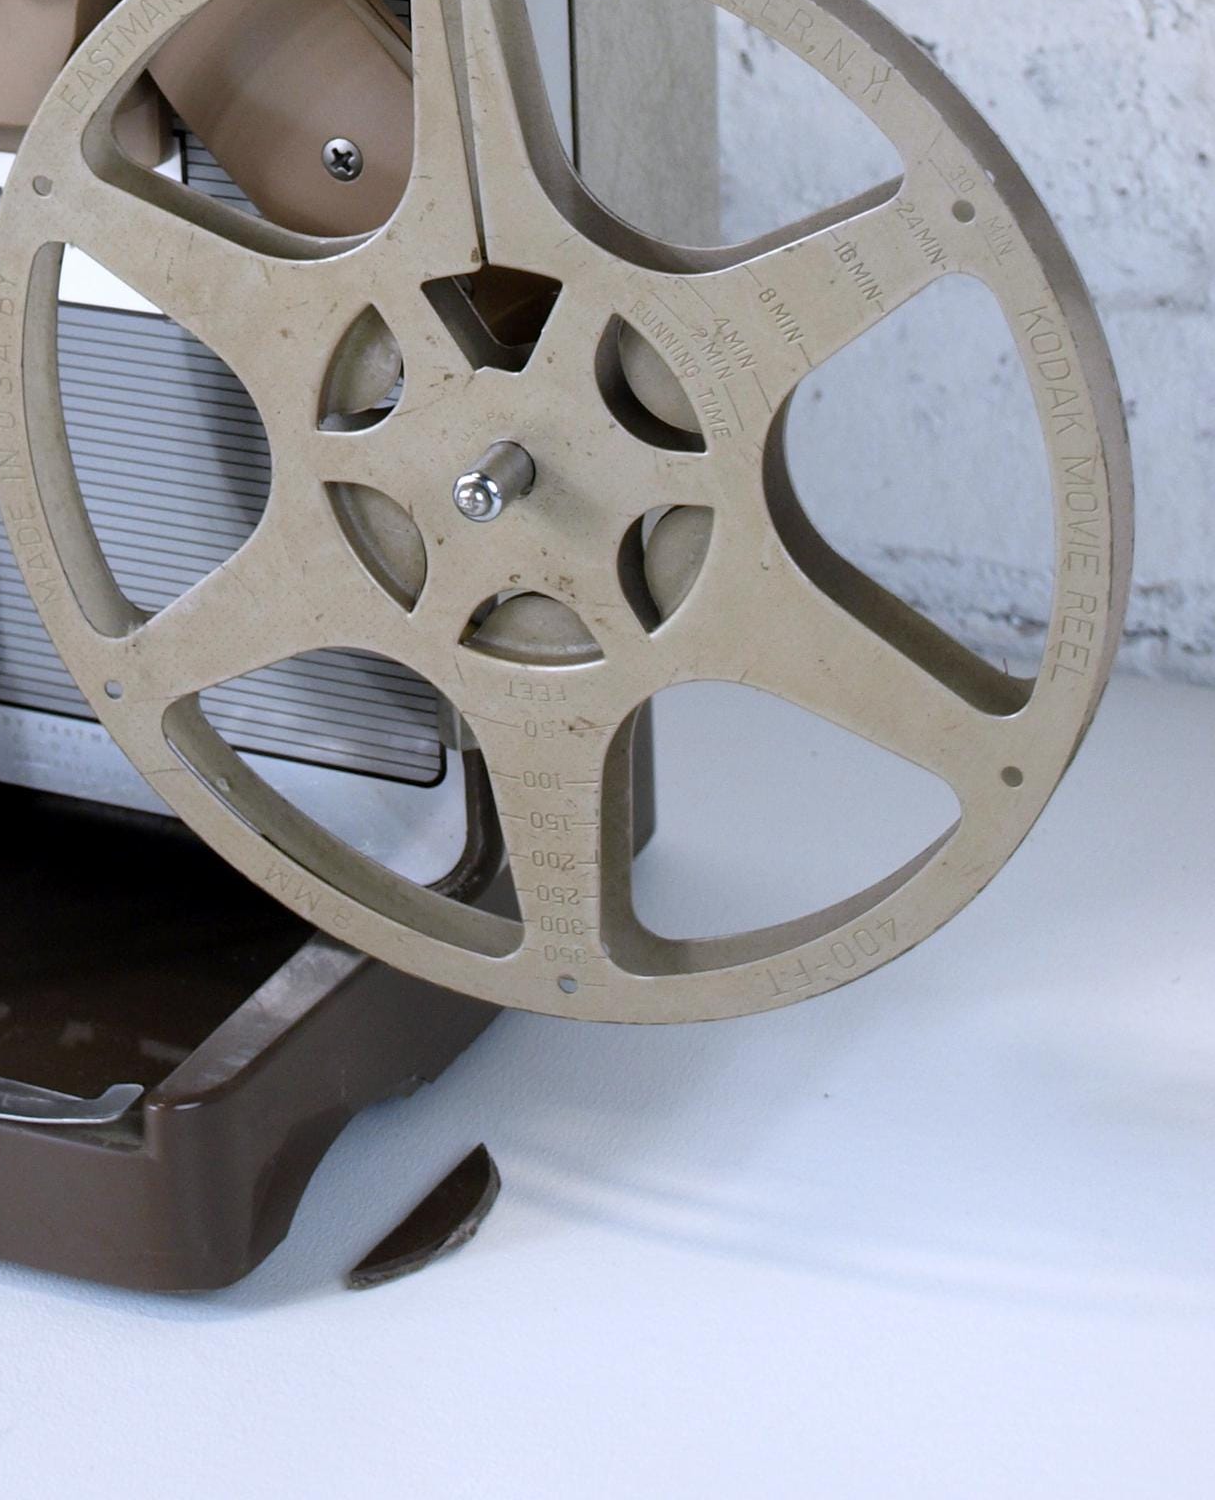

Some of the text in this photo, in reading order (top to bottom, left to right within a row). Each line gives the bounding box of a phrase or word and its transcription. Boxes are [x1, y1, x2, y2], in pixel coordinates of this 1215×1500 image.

[629, 300, 732, 440] RUNNING TIME
[1017, 305, 1101, 683] KODAK MOVIE REEL
[504, 680, 566, 702] FEET
[523, 770, 564, 790] 100
[529, 811, 572, 832] 150
[531, 849, 576, 871] 200
[536, 884, 581, 906] 250
[540, 915, 585, 936] 300
[543, 944, 588, 965] 350
